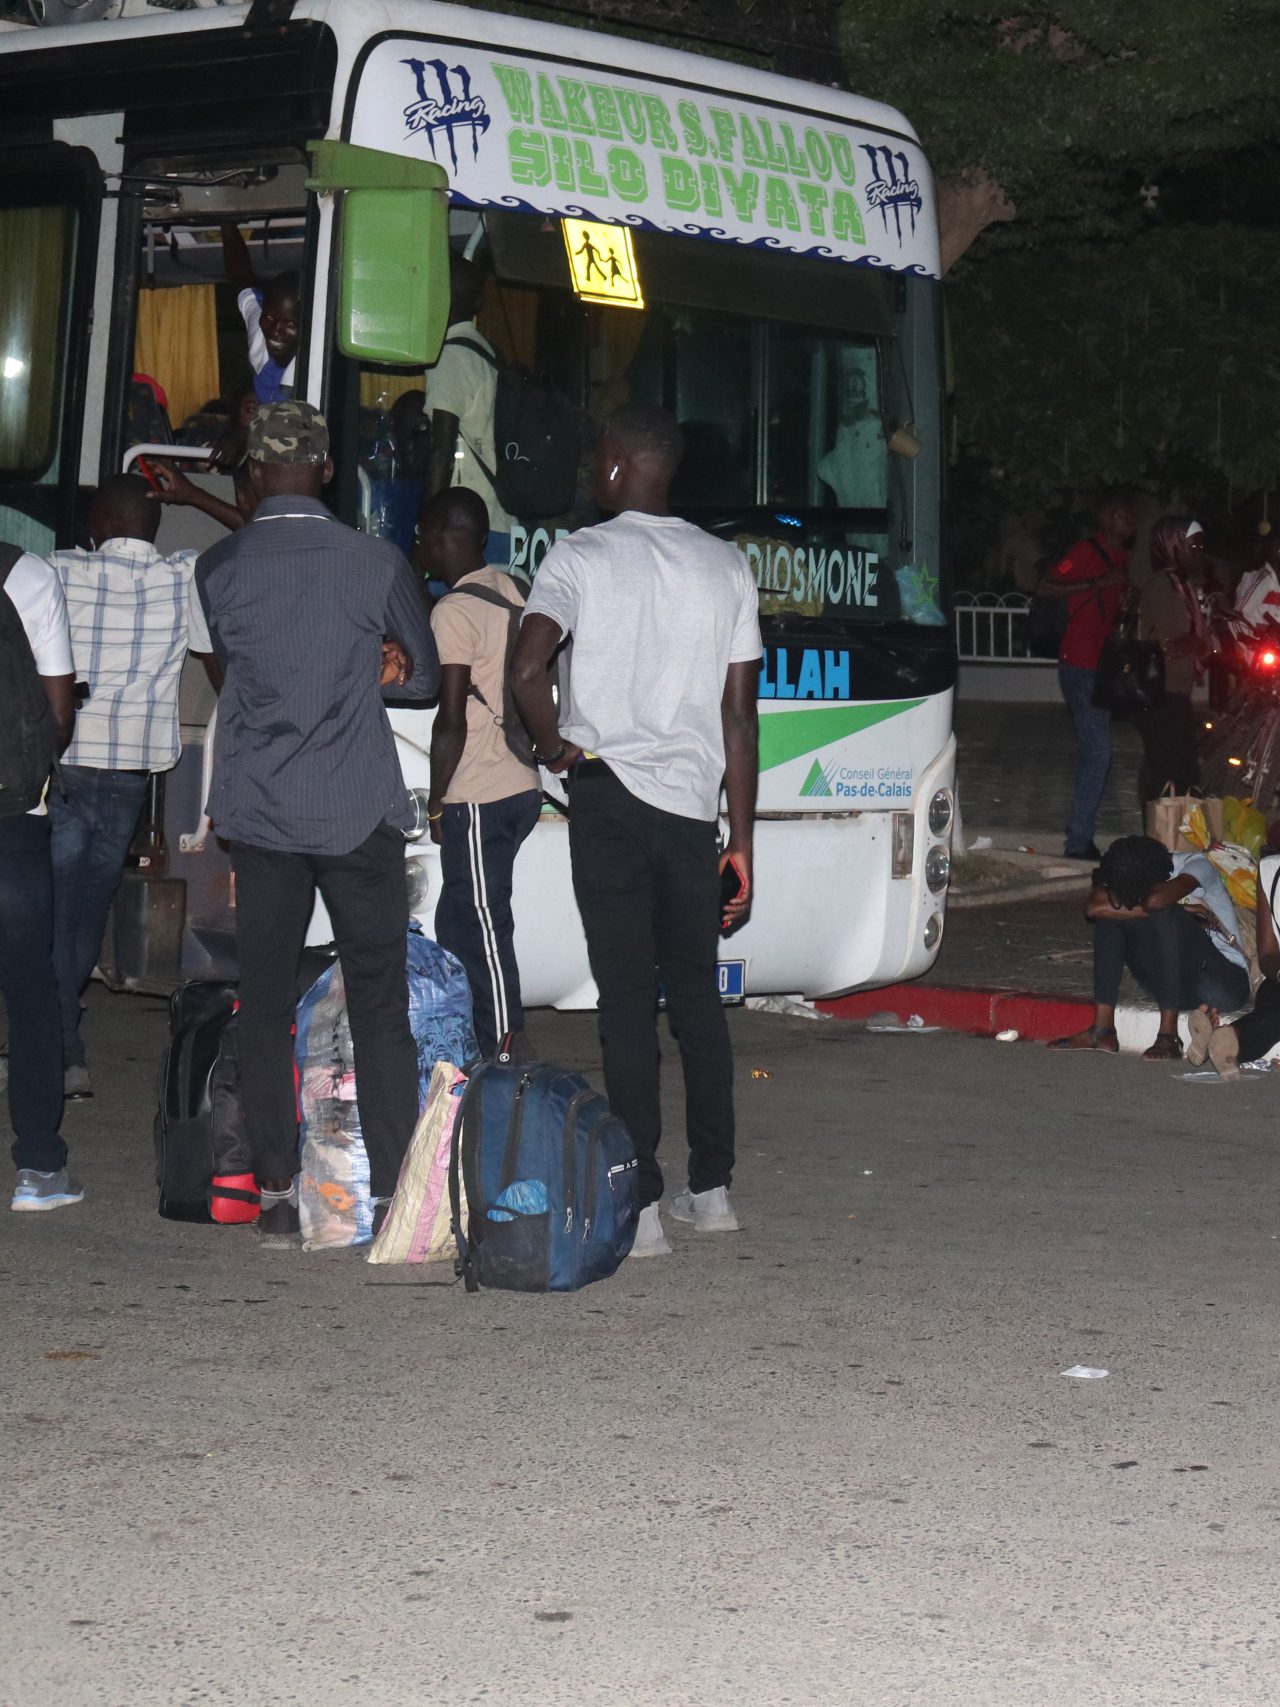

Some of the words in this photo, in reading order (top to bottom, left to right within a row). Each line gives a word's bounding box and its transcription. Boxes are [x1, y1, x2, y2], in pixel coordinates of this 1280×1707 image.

[403, 96, 485, 129] Racing
[490, 62, 677, 151] WAKEUR
[506, 127, 649, 204] SILO
[865, 178, 920, 205] Racing
[727, 541, 879, 607] DIOSMONE
[757, 647, 851, 700] LLAH
[839, 767, 875, 780] Conseil
[877, 766, 913, 780] Général
